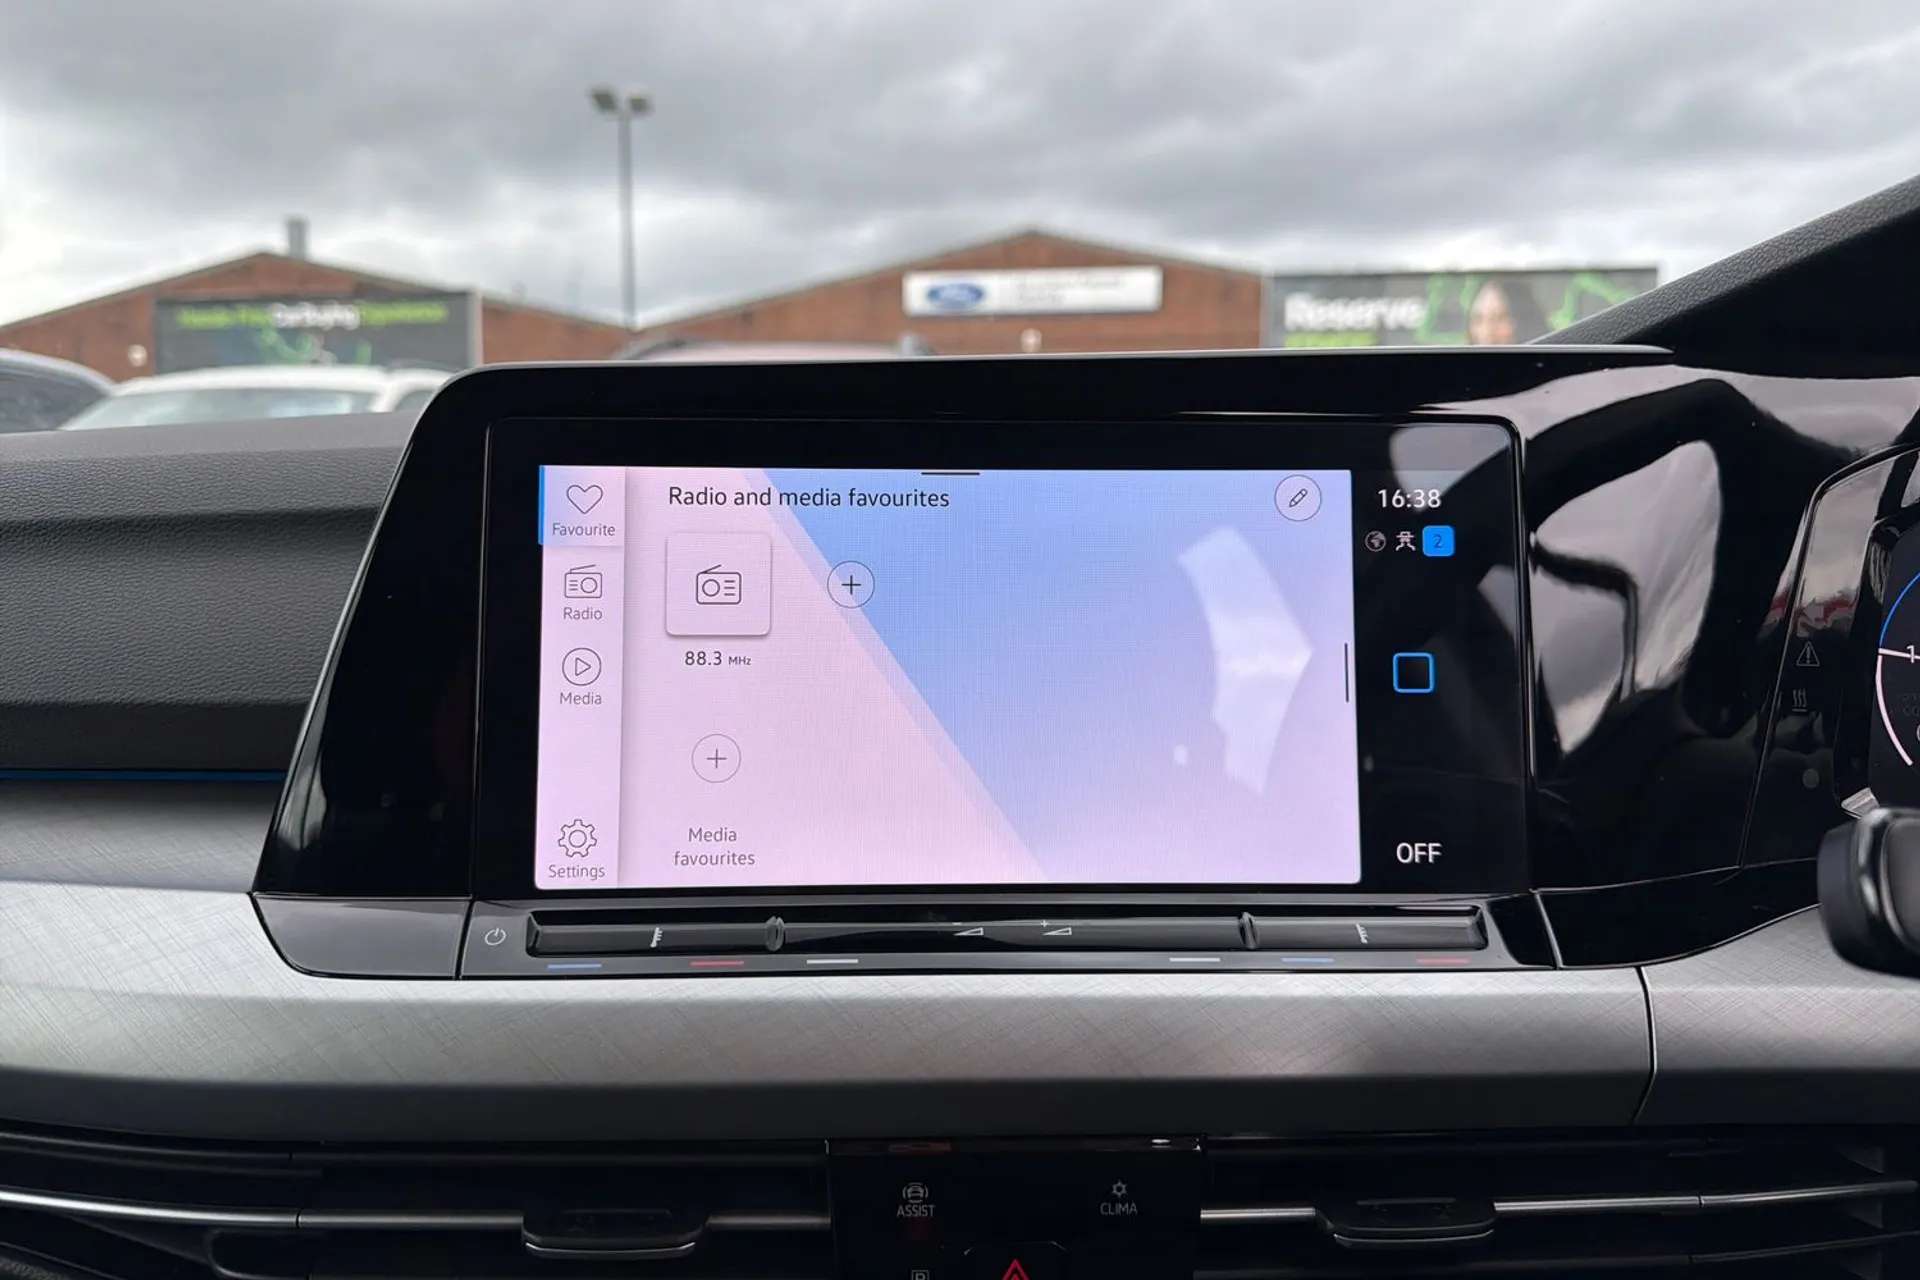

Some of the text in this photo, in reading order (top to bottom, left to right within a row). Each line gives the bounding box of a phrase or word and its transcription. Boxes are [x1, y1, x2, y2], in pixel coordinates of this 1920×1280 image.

[669, 486, 950, 508] Radio and media favourites
[1377, 488, 1442, 510] 16:38
[552, 522, 616, 537] Favourite
[563, 606, 603, 621] Radio
[684, 650, 752, 667] 88.3 MHz
[559, 691, 602, 705] Media
[688, 826, 737, 843] Media
[674, 850, 755, 866] favourites
[1396, 843, 1441, 864] OFF
[548, 864, 606, 882] Settings
[896, 1204, 936, 1218] ASSIST
[1100, 1202, 1138, 1216] CLIMA
